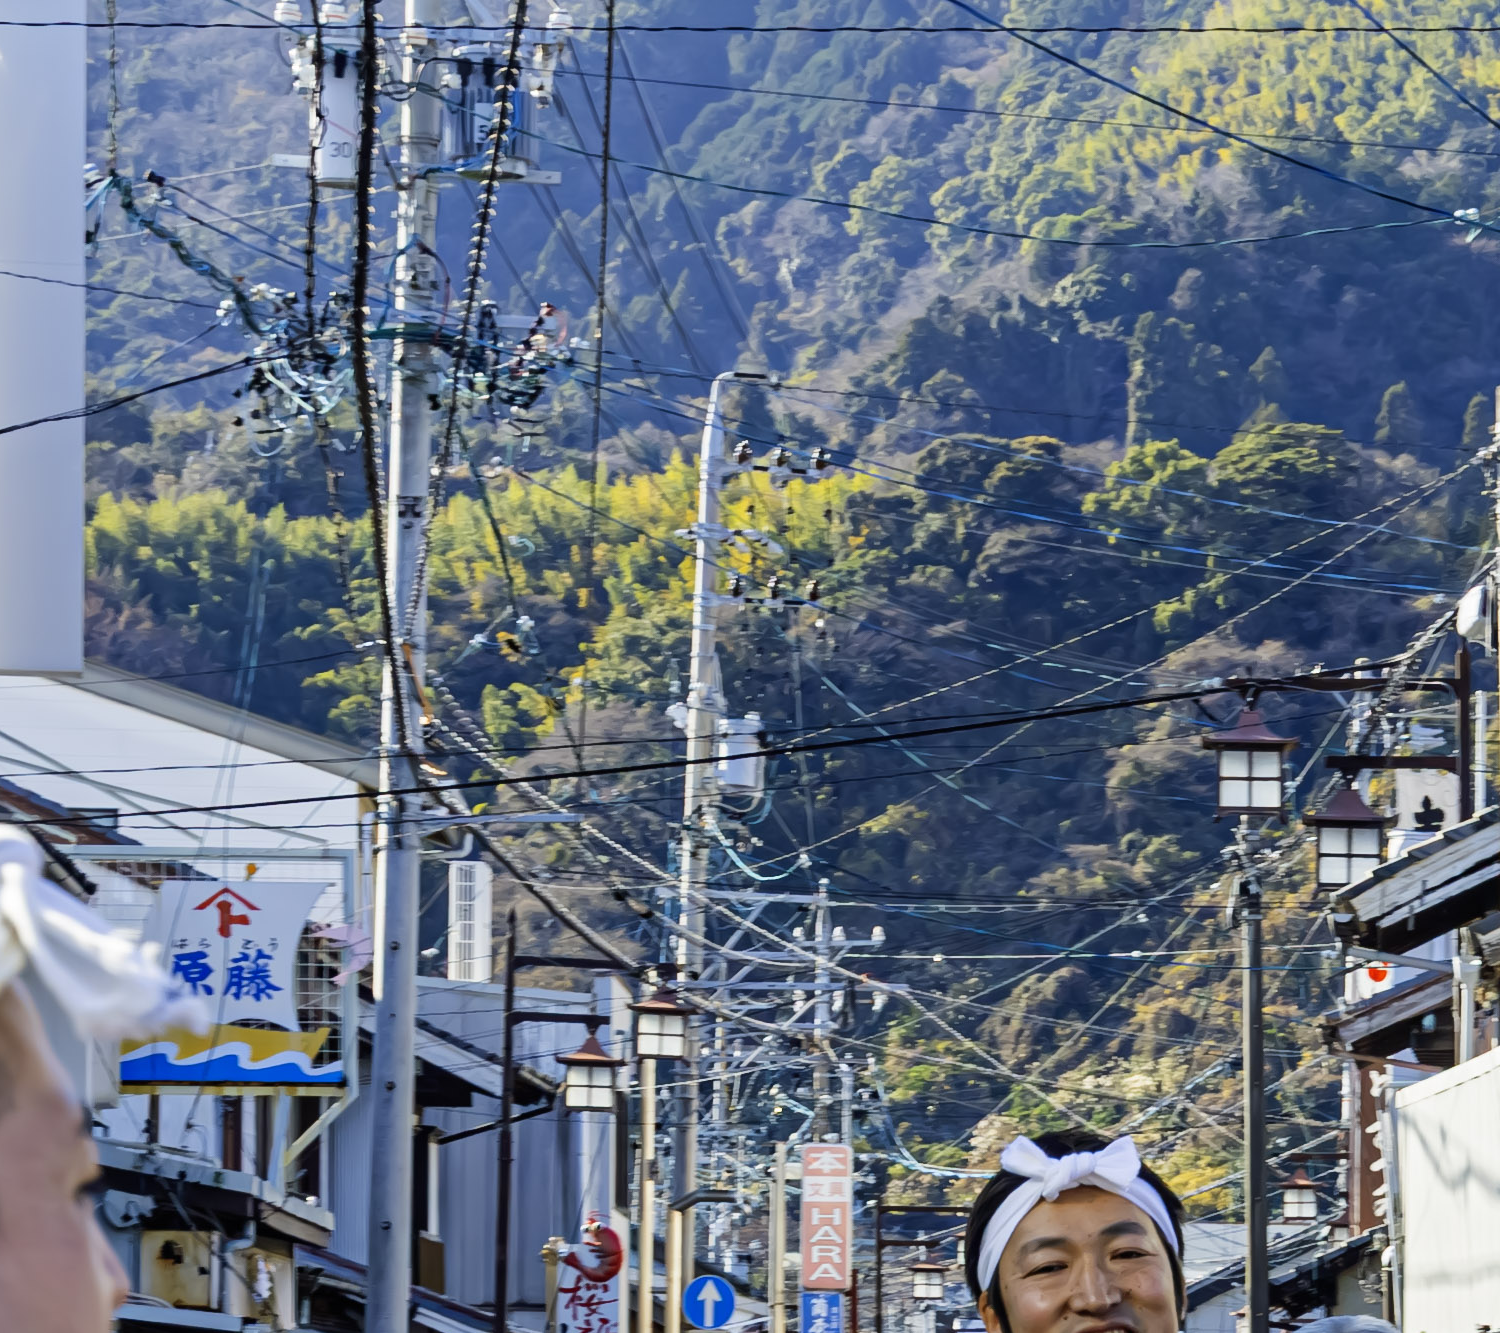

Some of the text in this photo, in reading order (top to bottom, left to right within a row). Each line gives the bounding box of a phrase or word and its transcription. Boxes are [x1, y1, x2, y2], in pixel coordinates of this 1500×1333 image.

[329, 140, 352, 159] 30
[172, 949, 284, 1002] 原藤
[807, 1150, 846, 1174] 本
[808, 1181, 846, 1198] 文具
[809, 1207, 844, 1281] HARA
